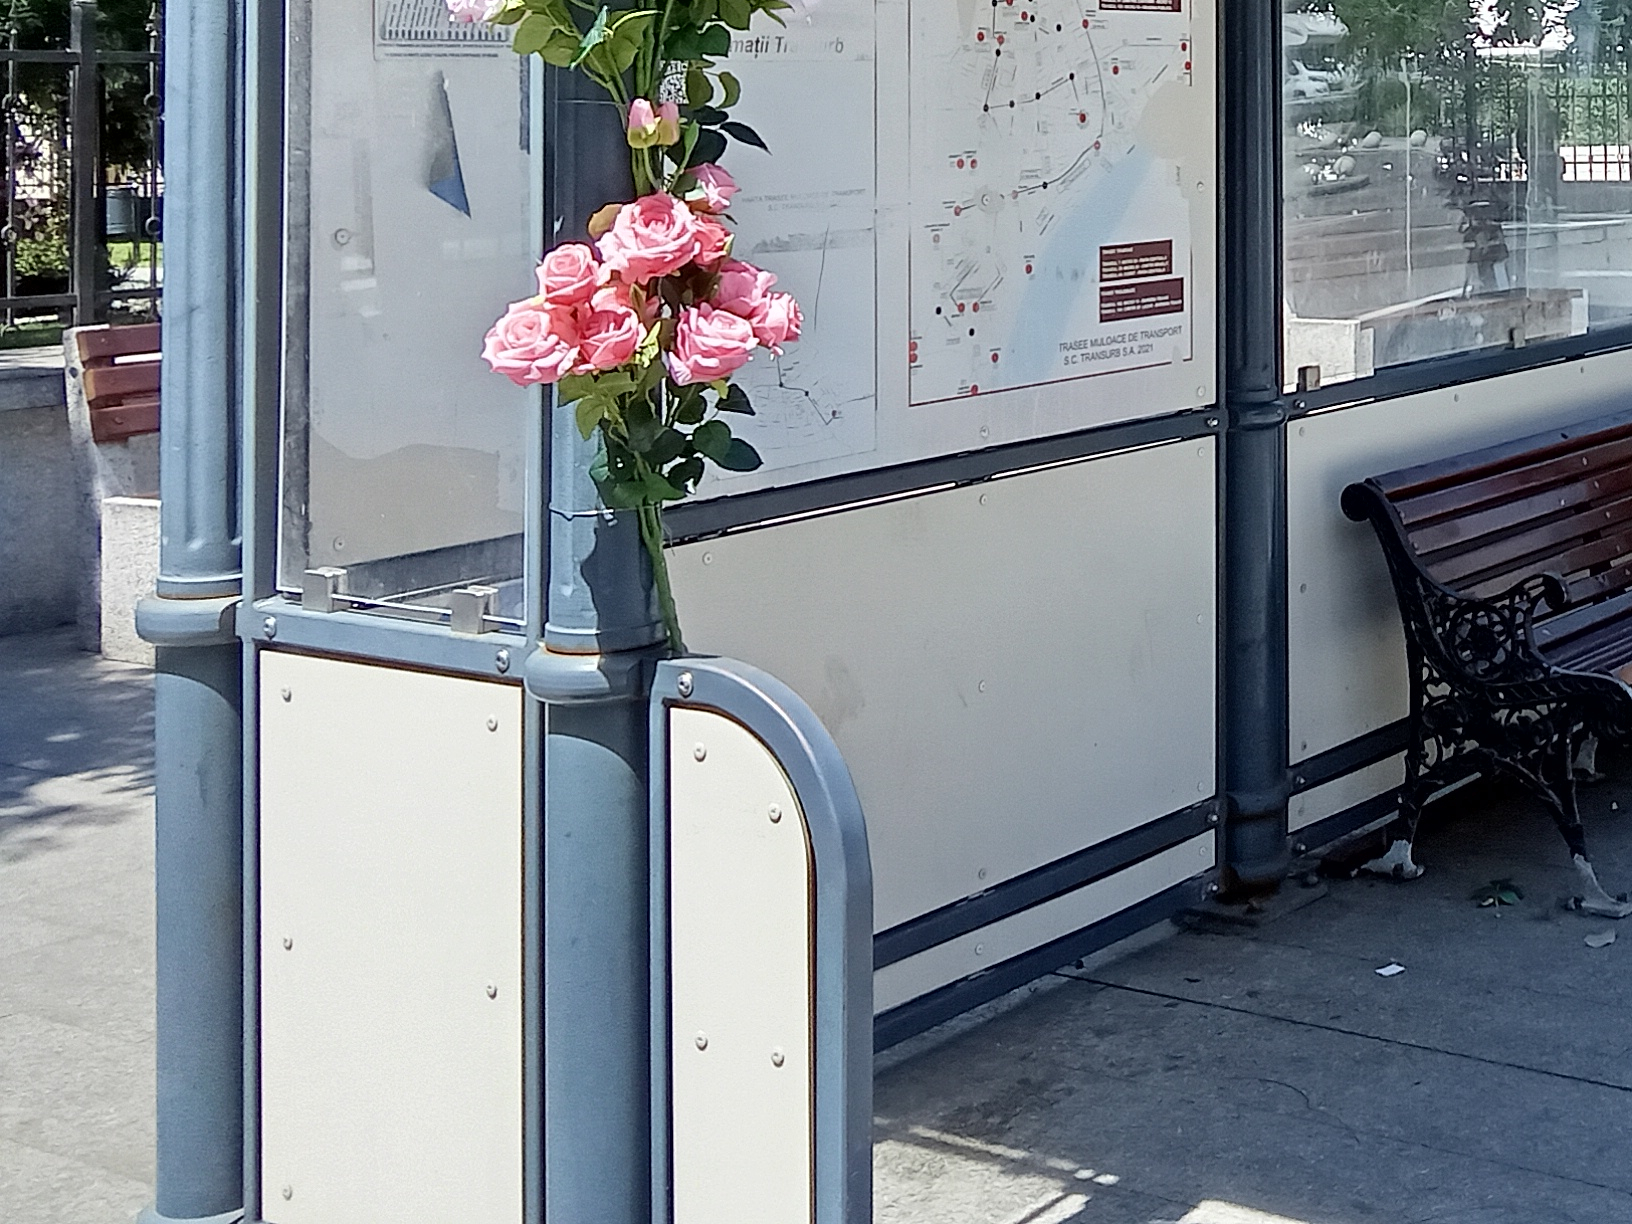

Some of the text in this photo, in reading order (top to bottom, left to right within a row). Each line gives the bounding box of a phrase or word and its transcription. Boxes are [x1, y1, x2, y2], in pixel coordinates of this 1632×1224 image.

[1059, 338, 1088, 352] TRASEE
[1128, 331, 1139, 342] DE
[1140, 325, 1183, 340] TRANSPORT
